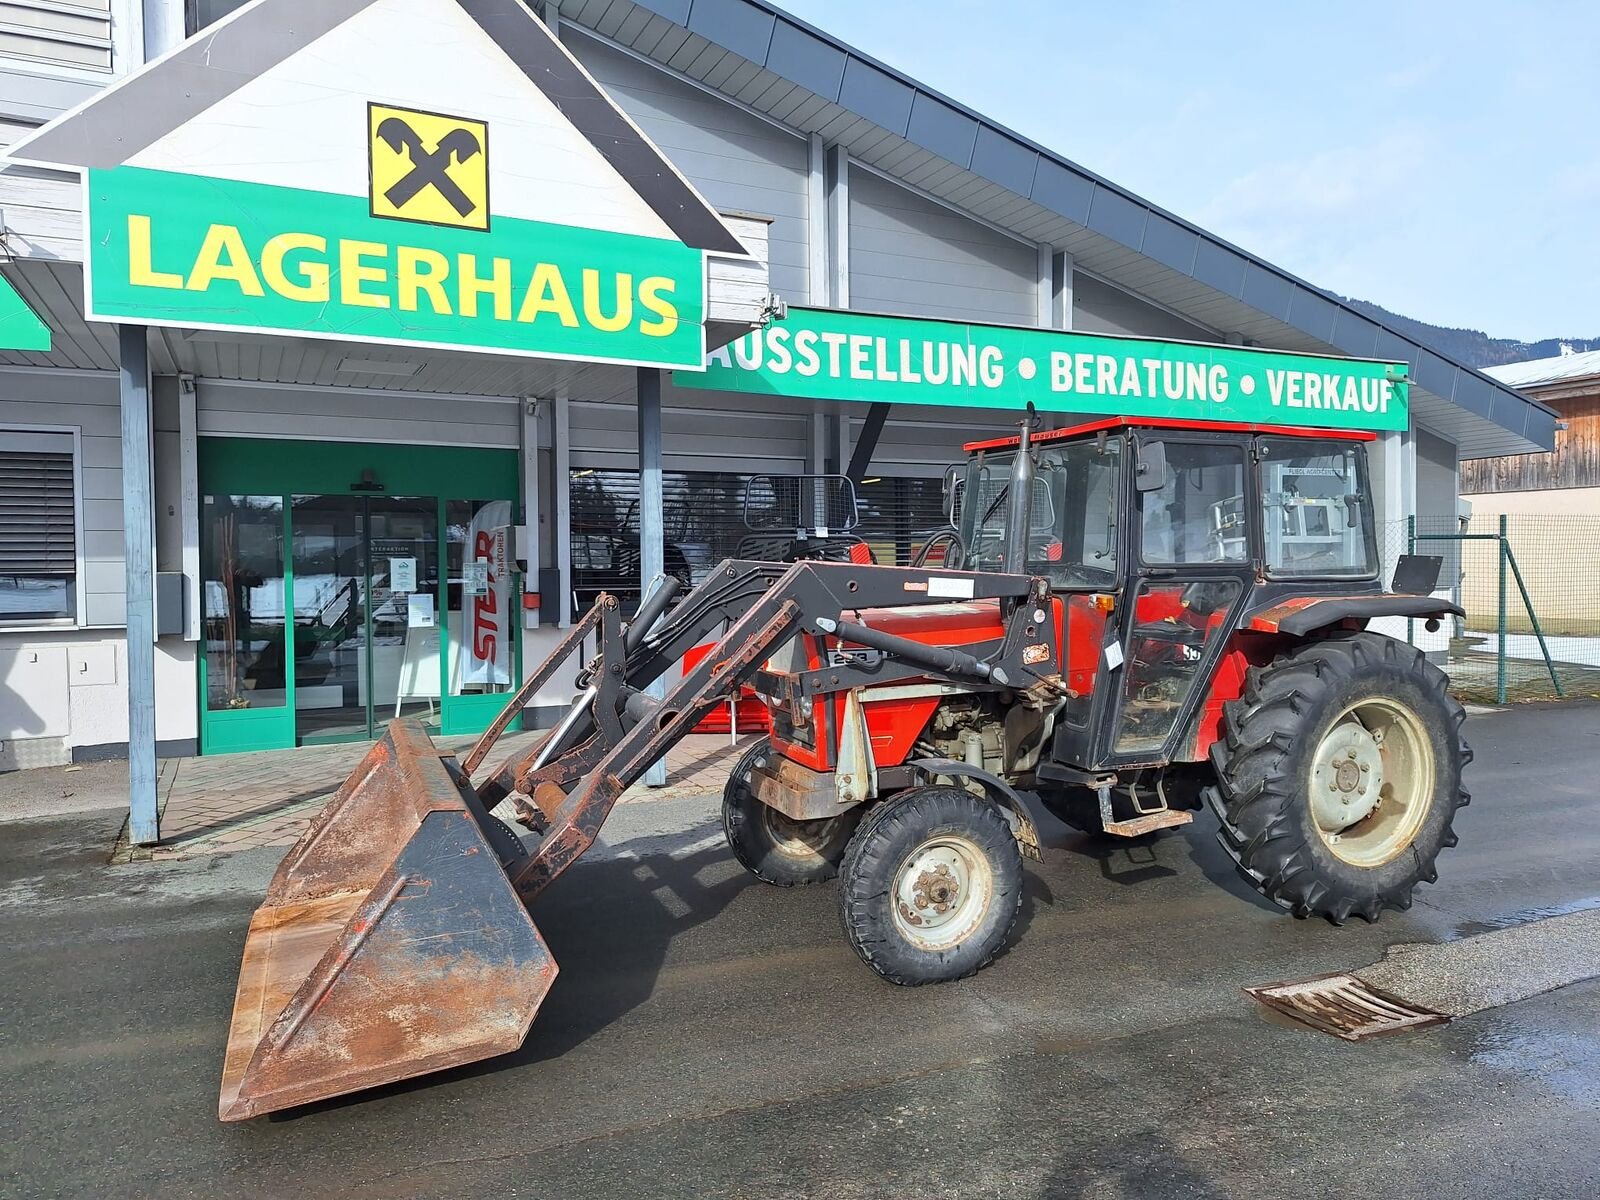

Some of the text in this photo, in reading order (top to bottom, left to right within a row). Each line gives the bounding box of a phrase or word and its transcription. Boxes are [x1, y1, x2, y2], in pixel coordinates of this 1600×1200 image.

[127, 214, 679, 337] LAGERHAUS
[1050, 351, 1229, 403] BERATUNG
[1265, 368, 1395, 414] VERKAUF
[474, 530, 498, 666] STER
[497, 531, 505, 577] TRAKTOREN
